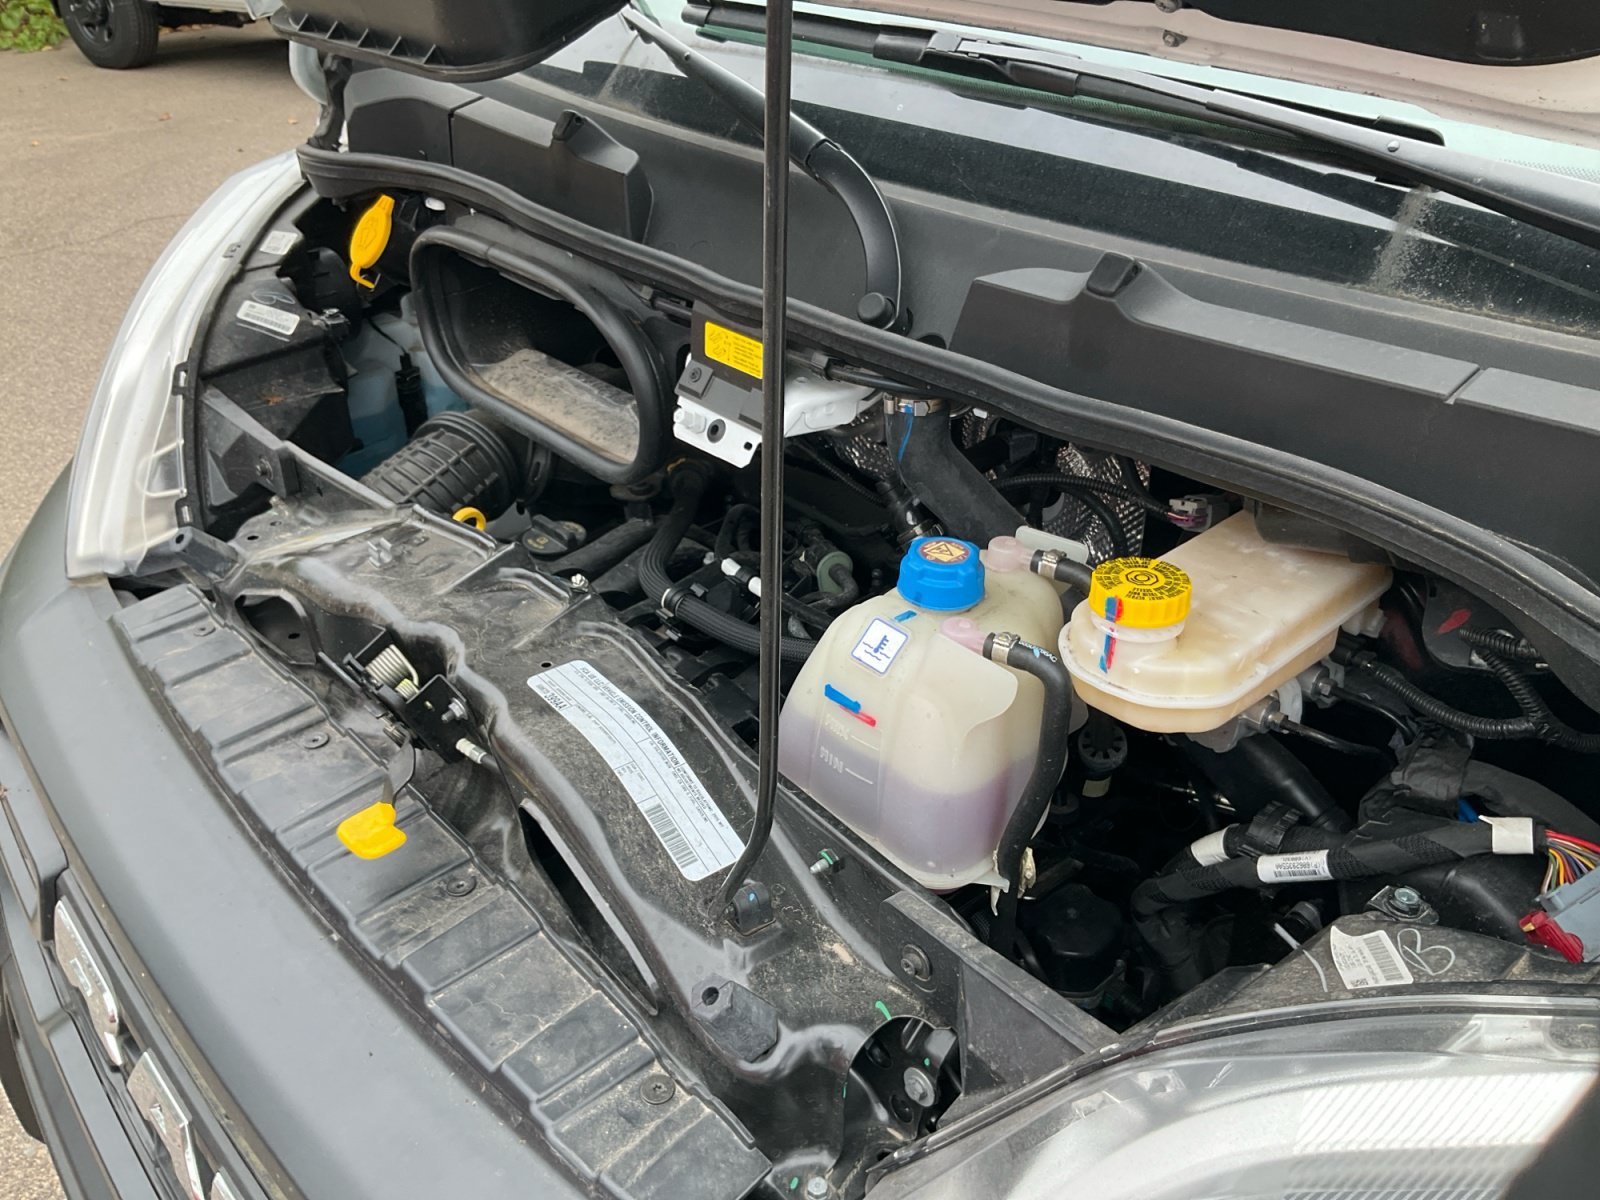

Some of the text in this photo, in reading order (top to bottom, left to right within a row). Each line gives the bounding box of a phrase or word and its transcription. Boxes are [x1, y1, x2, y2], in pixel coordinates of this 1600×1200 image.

[602, 685, 619, 699] VEHICLE
[616, 697, 636, 714] EMISSION
[634, 713, 653, 734] CONTROL
[652, 732, 680, 766] INFORMATION
[819, 745, 844, 774] MIN
